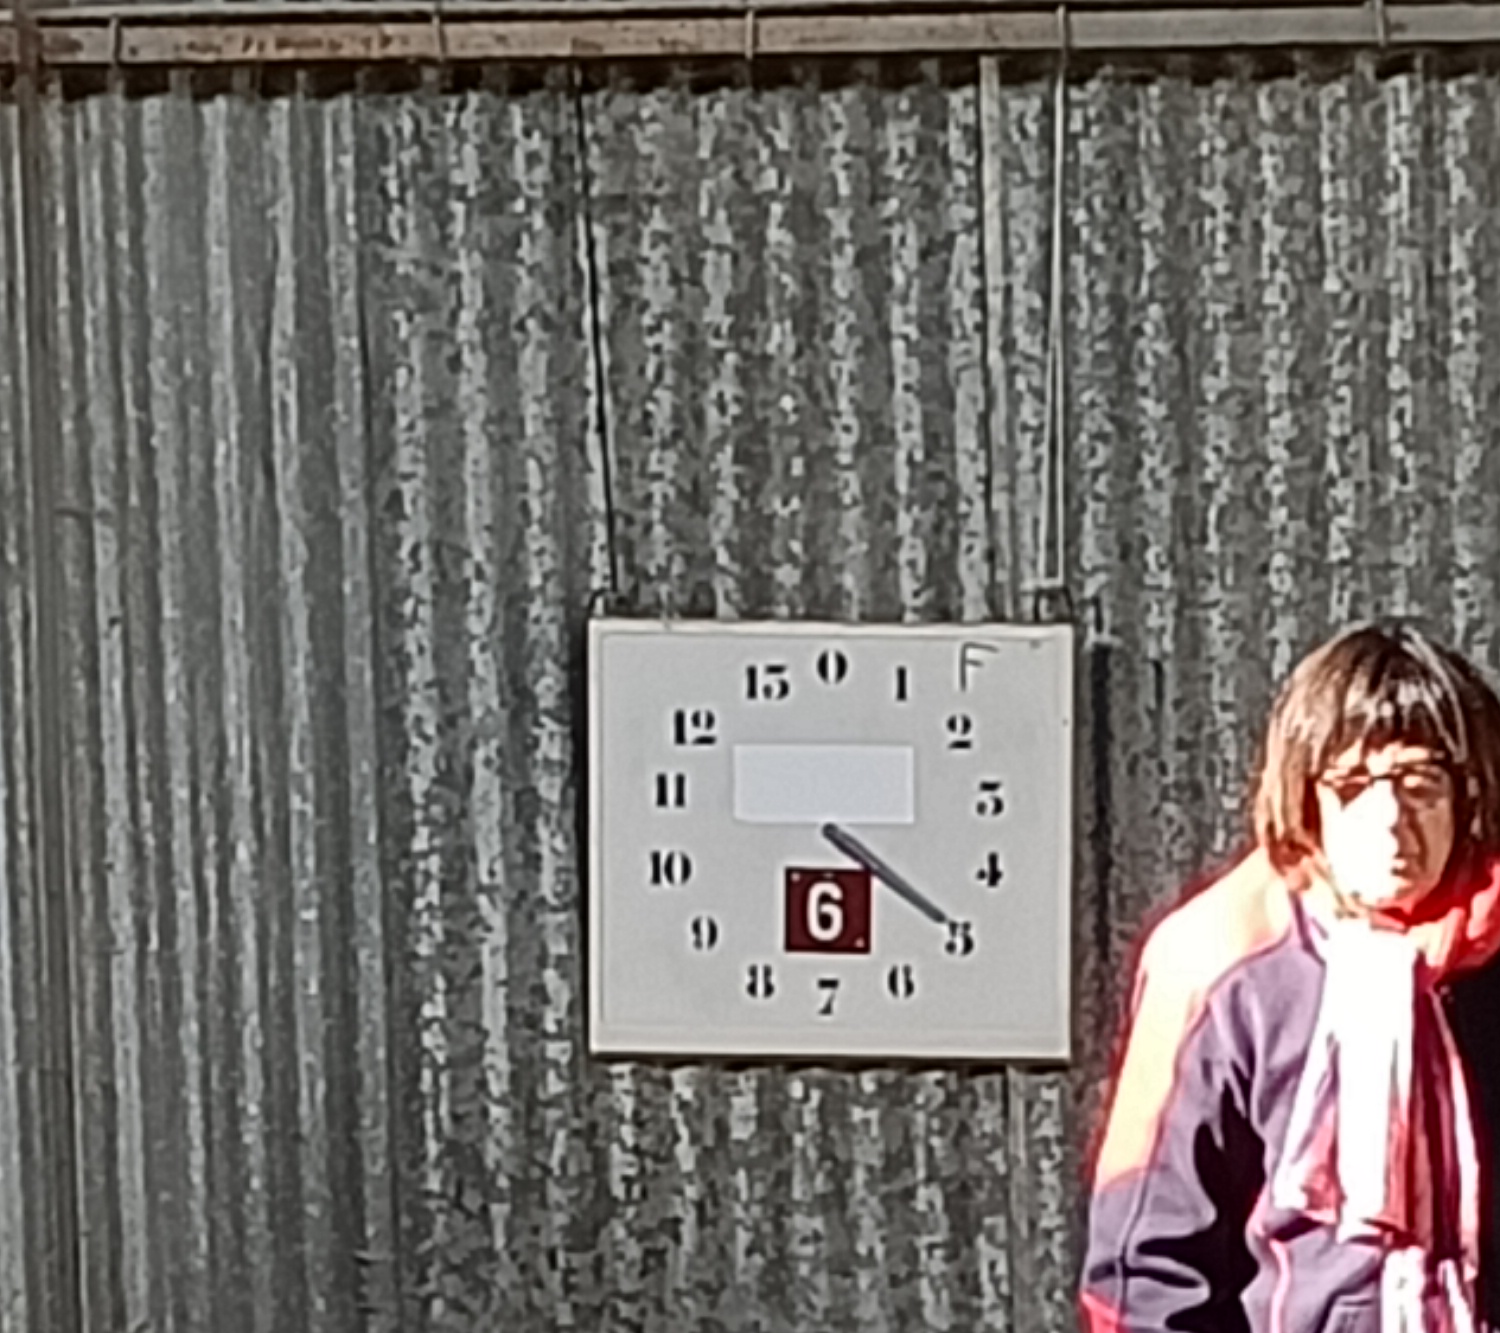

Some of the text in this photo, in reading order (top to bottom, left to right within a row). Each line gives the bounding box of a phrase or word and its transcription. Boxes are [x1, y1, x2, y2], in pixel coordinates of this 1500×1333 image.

[817, 649, 848, 684] 0
[896, 666, 907, 701] 1
[960, 640, 1000, 692] F
[674, 709, 716, 745] 12
[946, 714, 972, 749] 2
[656, 773, 685, 808] 11
[650, 850, 692, 885] 10
[976, 852, 1003, 888] 4
[807, 882, 843, 941] 6
[692, 916, 718, 951] 9
[746, 964, 775, 999] 8
[816, 979, 840, 1016] 7
[888, 964, 915, 998] 6
